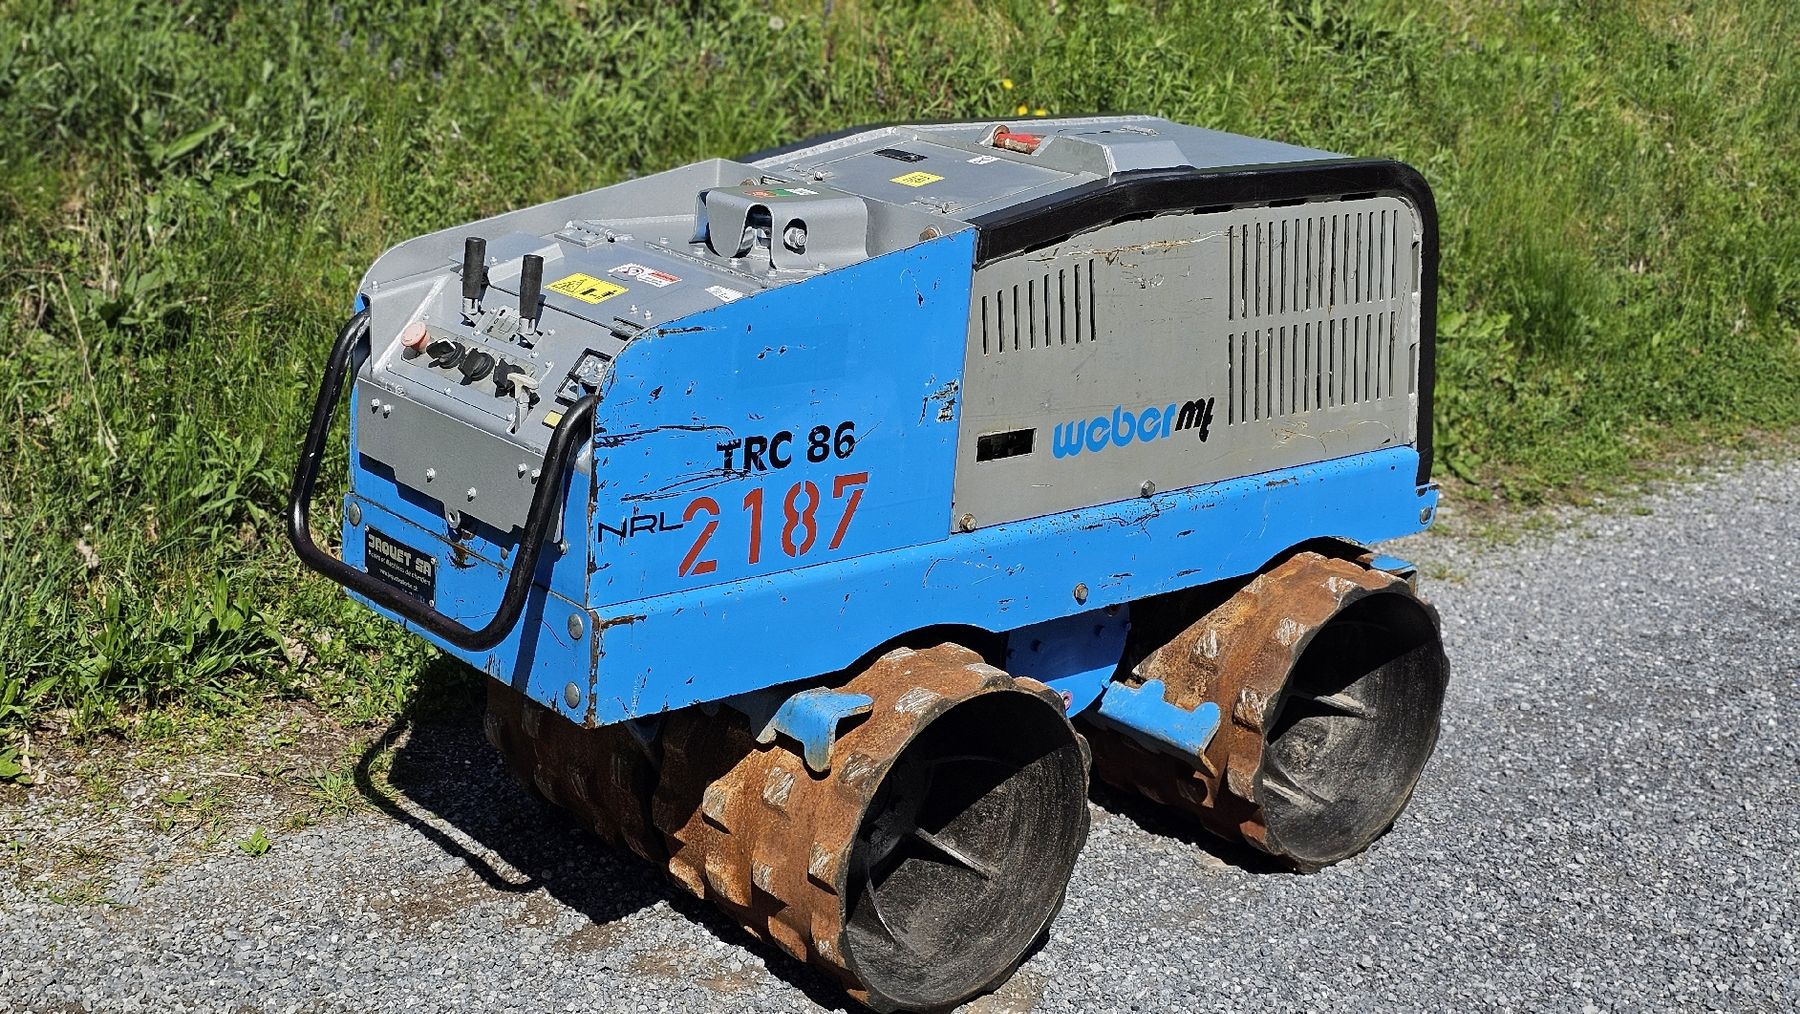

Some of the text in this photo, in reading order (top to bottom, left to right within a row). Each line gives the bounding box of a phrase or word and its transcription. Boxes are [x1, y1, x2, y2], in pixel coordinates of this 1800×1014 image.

[717, 421, 855, 471] TRC 86
[1053, 404, 1177, 459] weber
[598, 471, 869, 577] NRL 2187
[369, 534, 431, 577] JAQUET SA
